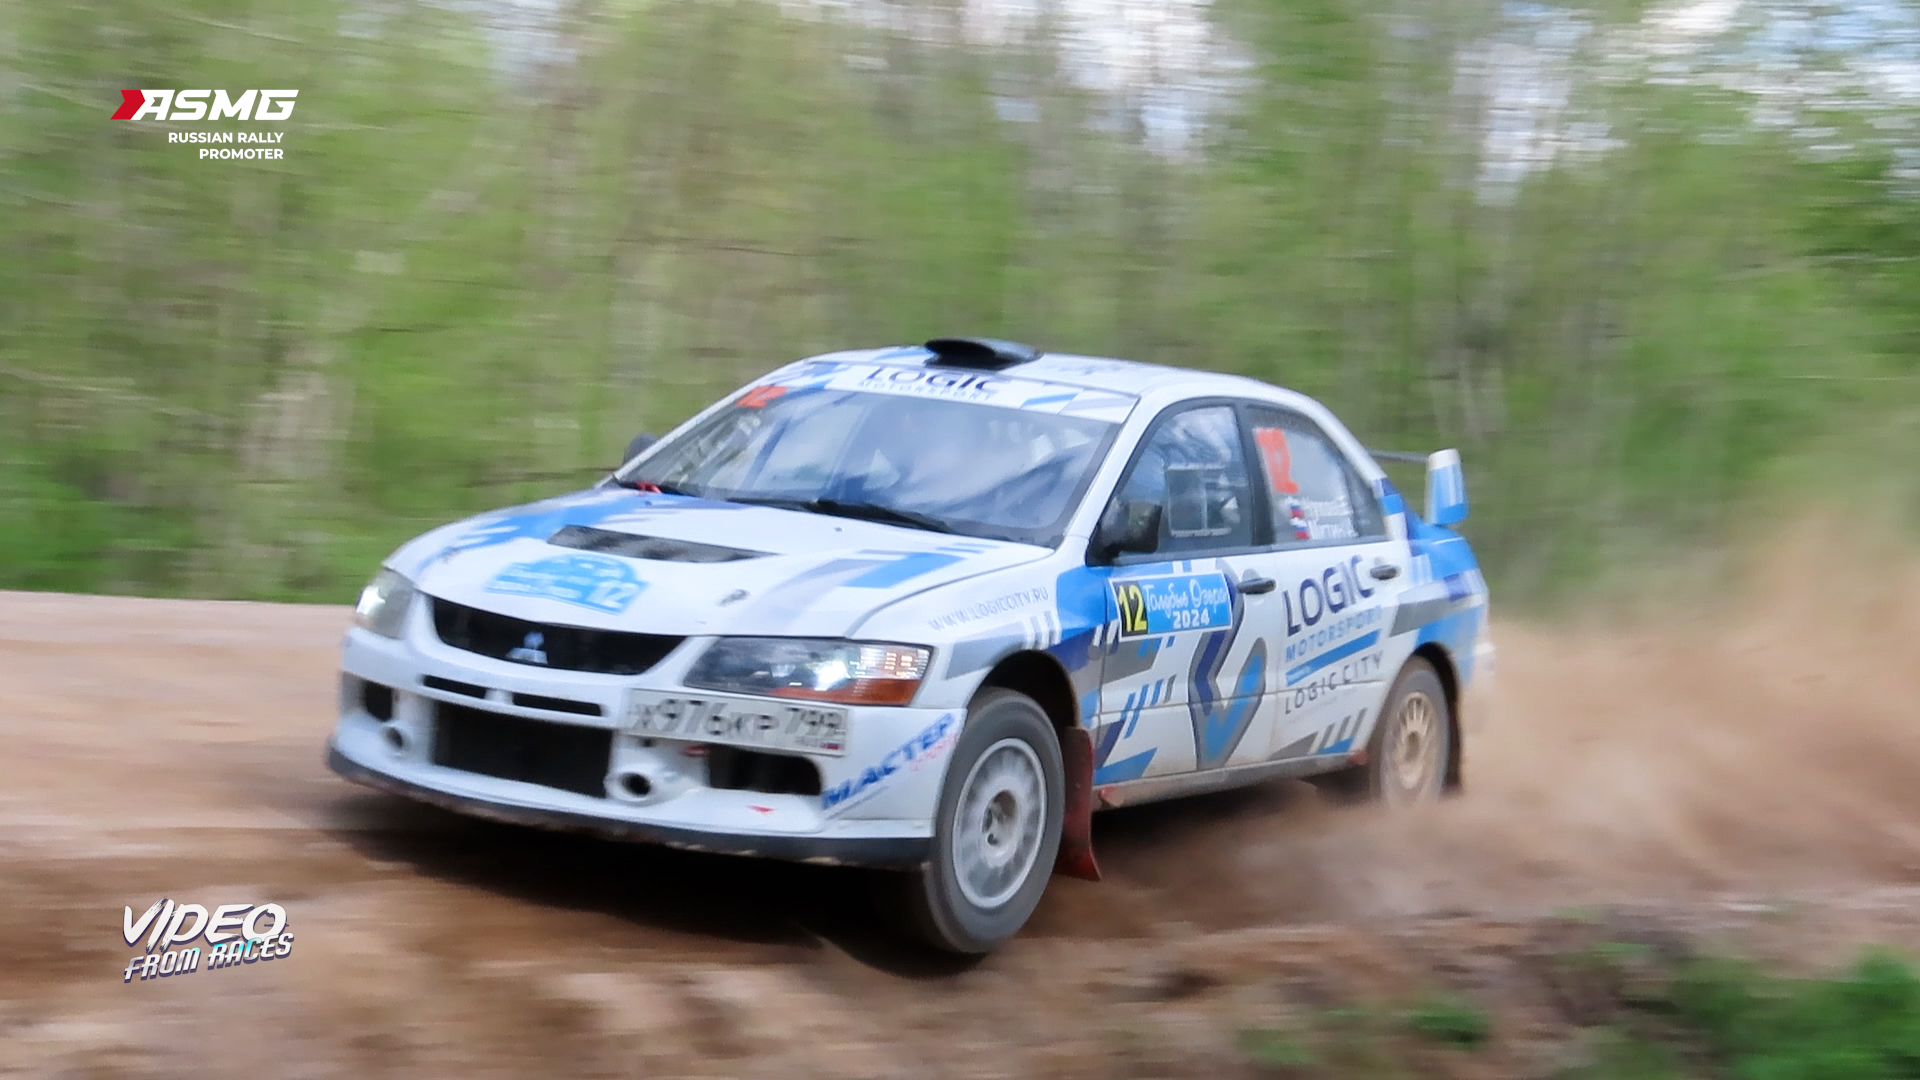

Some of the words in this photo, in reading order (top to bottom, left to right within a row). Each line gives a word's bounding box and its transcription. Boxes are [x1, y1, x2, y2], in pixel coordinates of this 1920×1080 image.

[865, 366, 1004, 391] LOGIC
[1118, 584, 1148, 633] 12
[1172, 607, 1211, 630] 2024
[1282, 554, 1376, 638] LOGIC
[1285, 604, 1382, 663] MOTORSPORT
